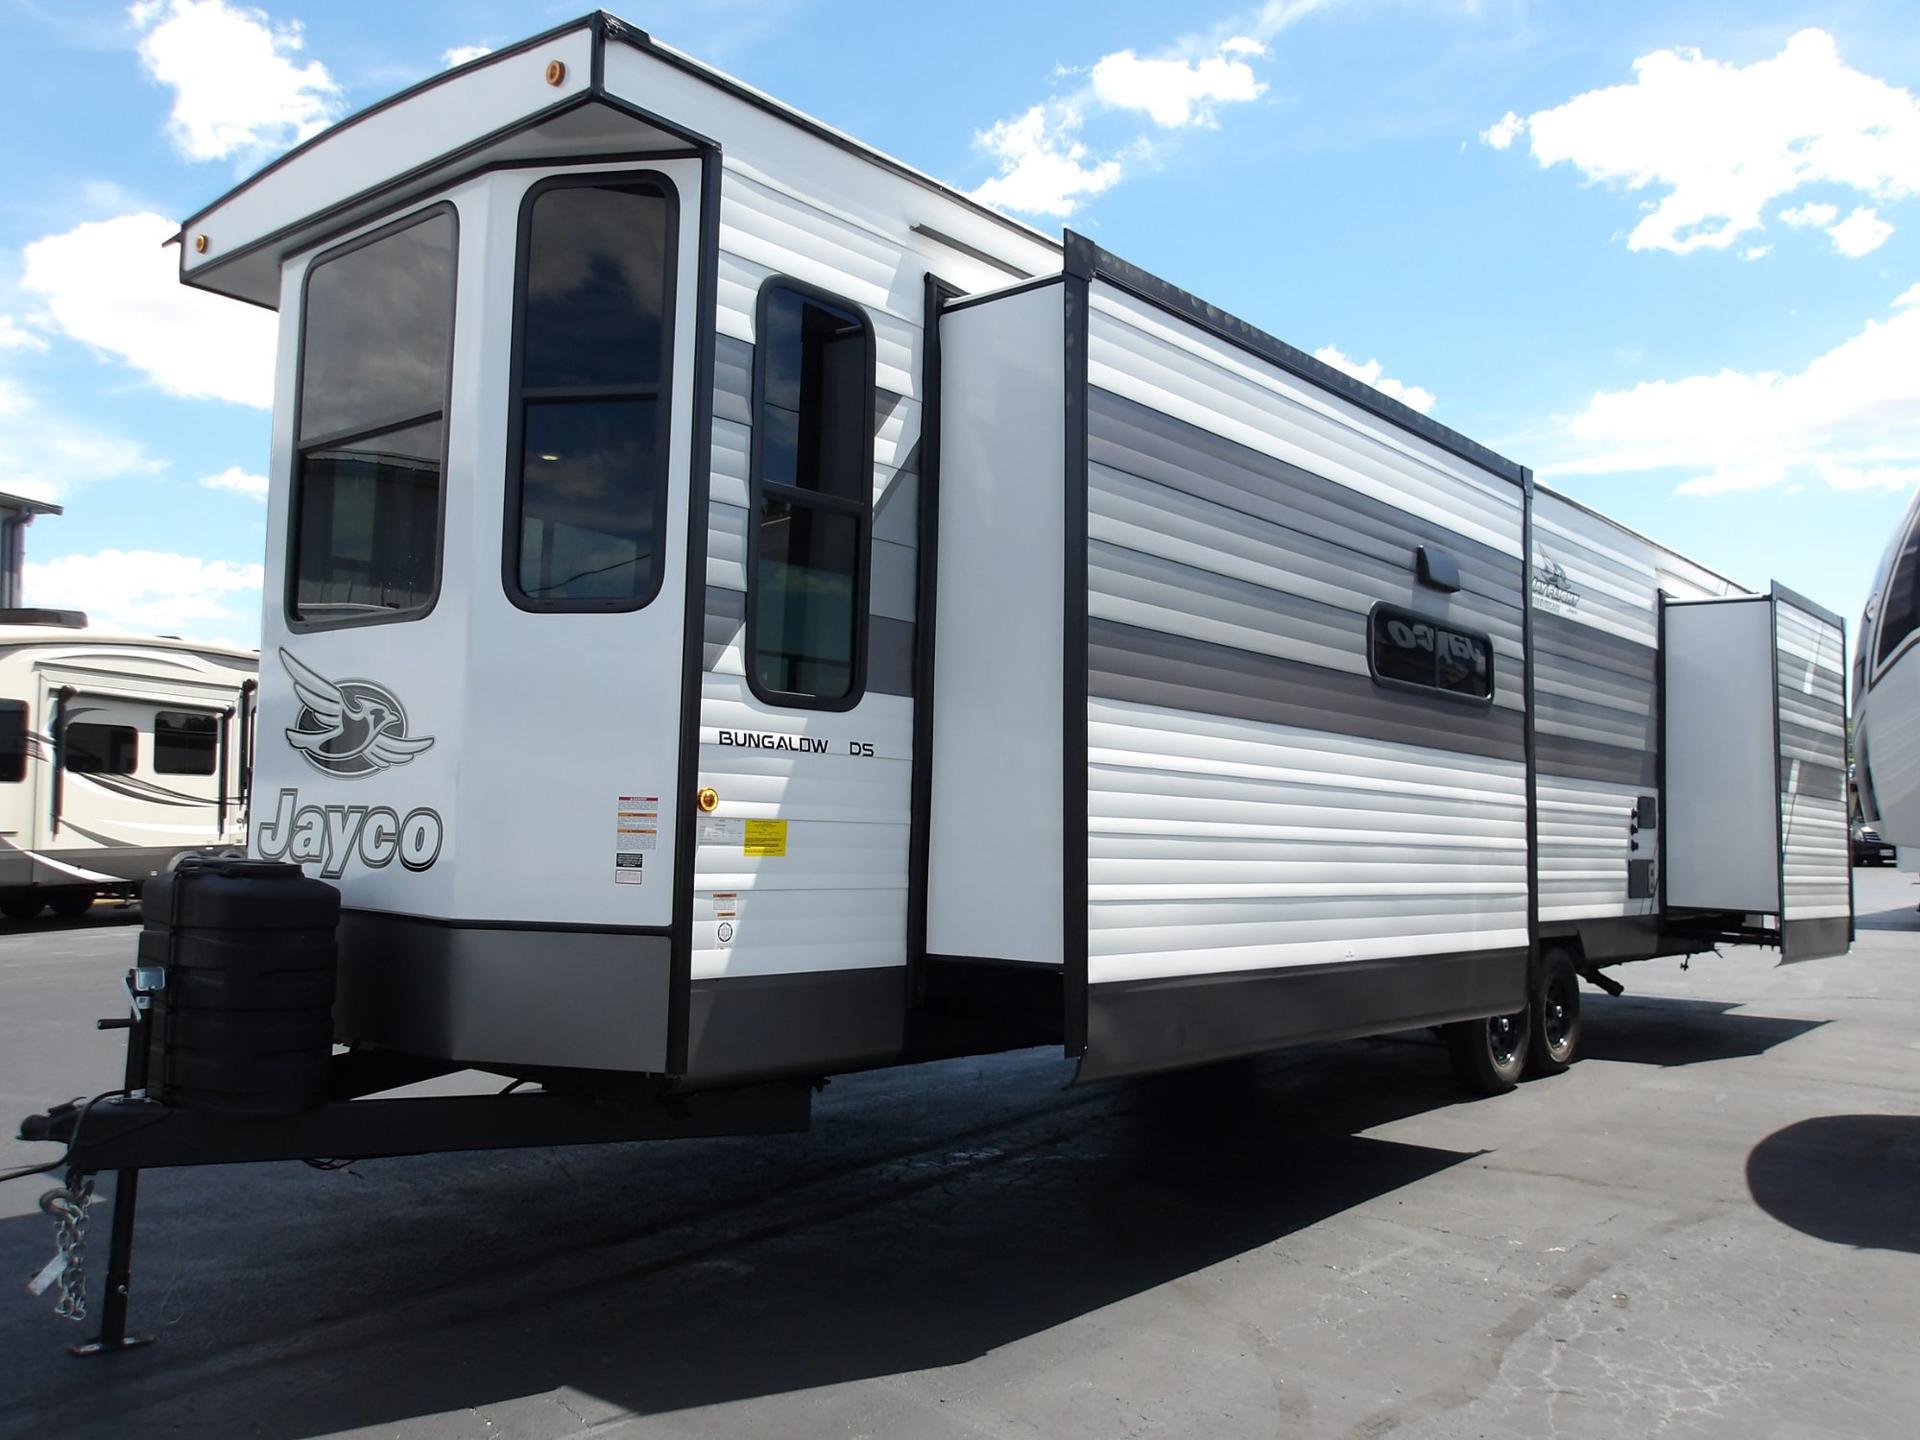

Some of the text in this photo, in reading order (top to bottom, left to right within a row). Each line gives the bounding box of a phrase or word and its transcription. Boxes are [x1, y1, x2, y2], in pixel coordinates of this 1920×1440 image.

[1548, 584, 1580, 607] FLIGHT
[719, 731, 874, 757] BUNGALOW DS
[257, 788, 443, 879] Jayco
